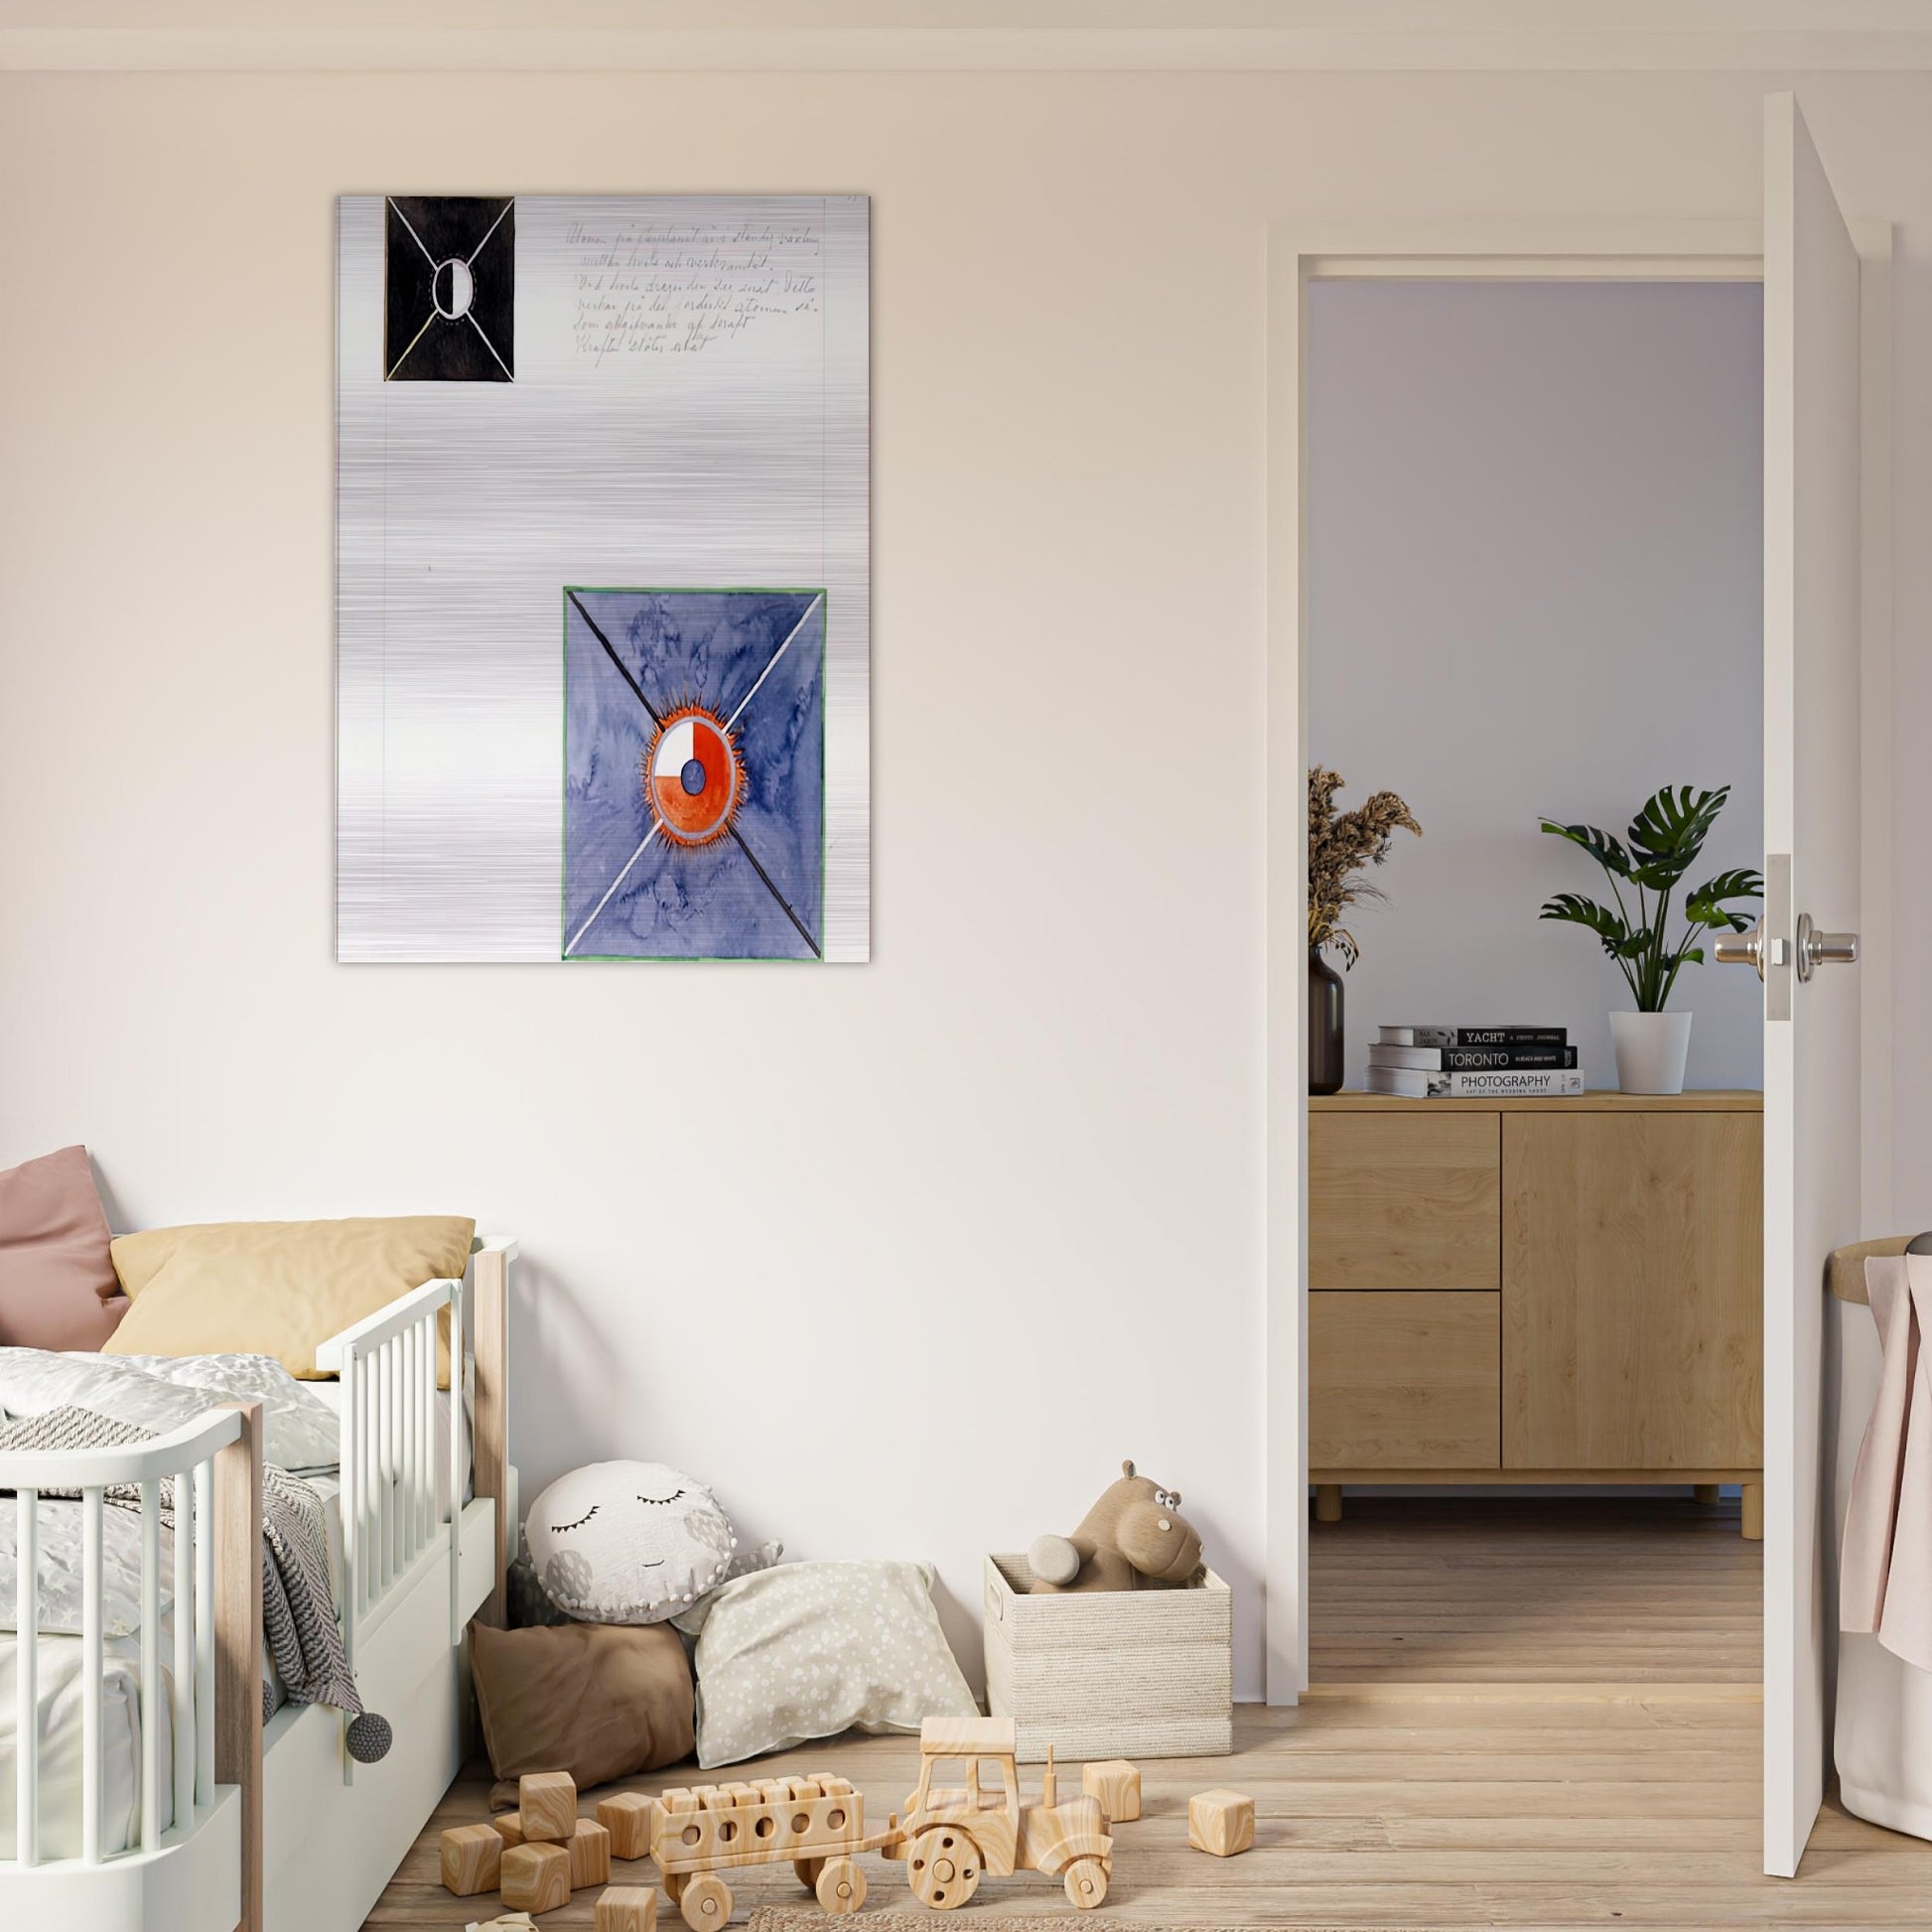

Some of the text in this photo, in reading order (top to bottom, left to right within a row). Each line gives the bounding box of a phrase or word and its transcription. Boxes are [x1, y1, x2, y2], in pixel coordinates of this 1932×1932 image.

[1466, 1033, 1506, 1043] YACHT
[1449, 1052, 1509, 1066] TORONTO
[1460, 1075, 1551, 1087] PHOTOGRAPHY
